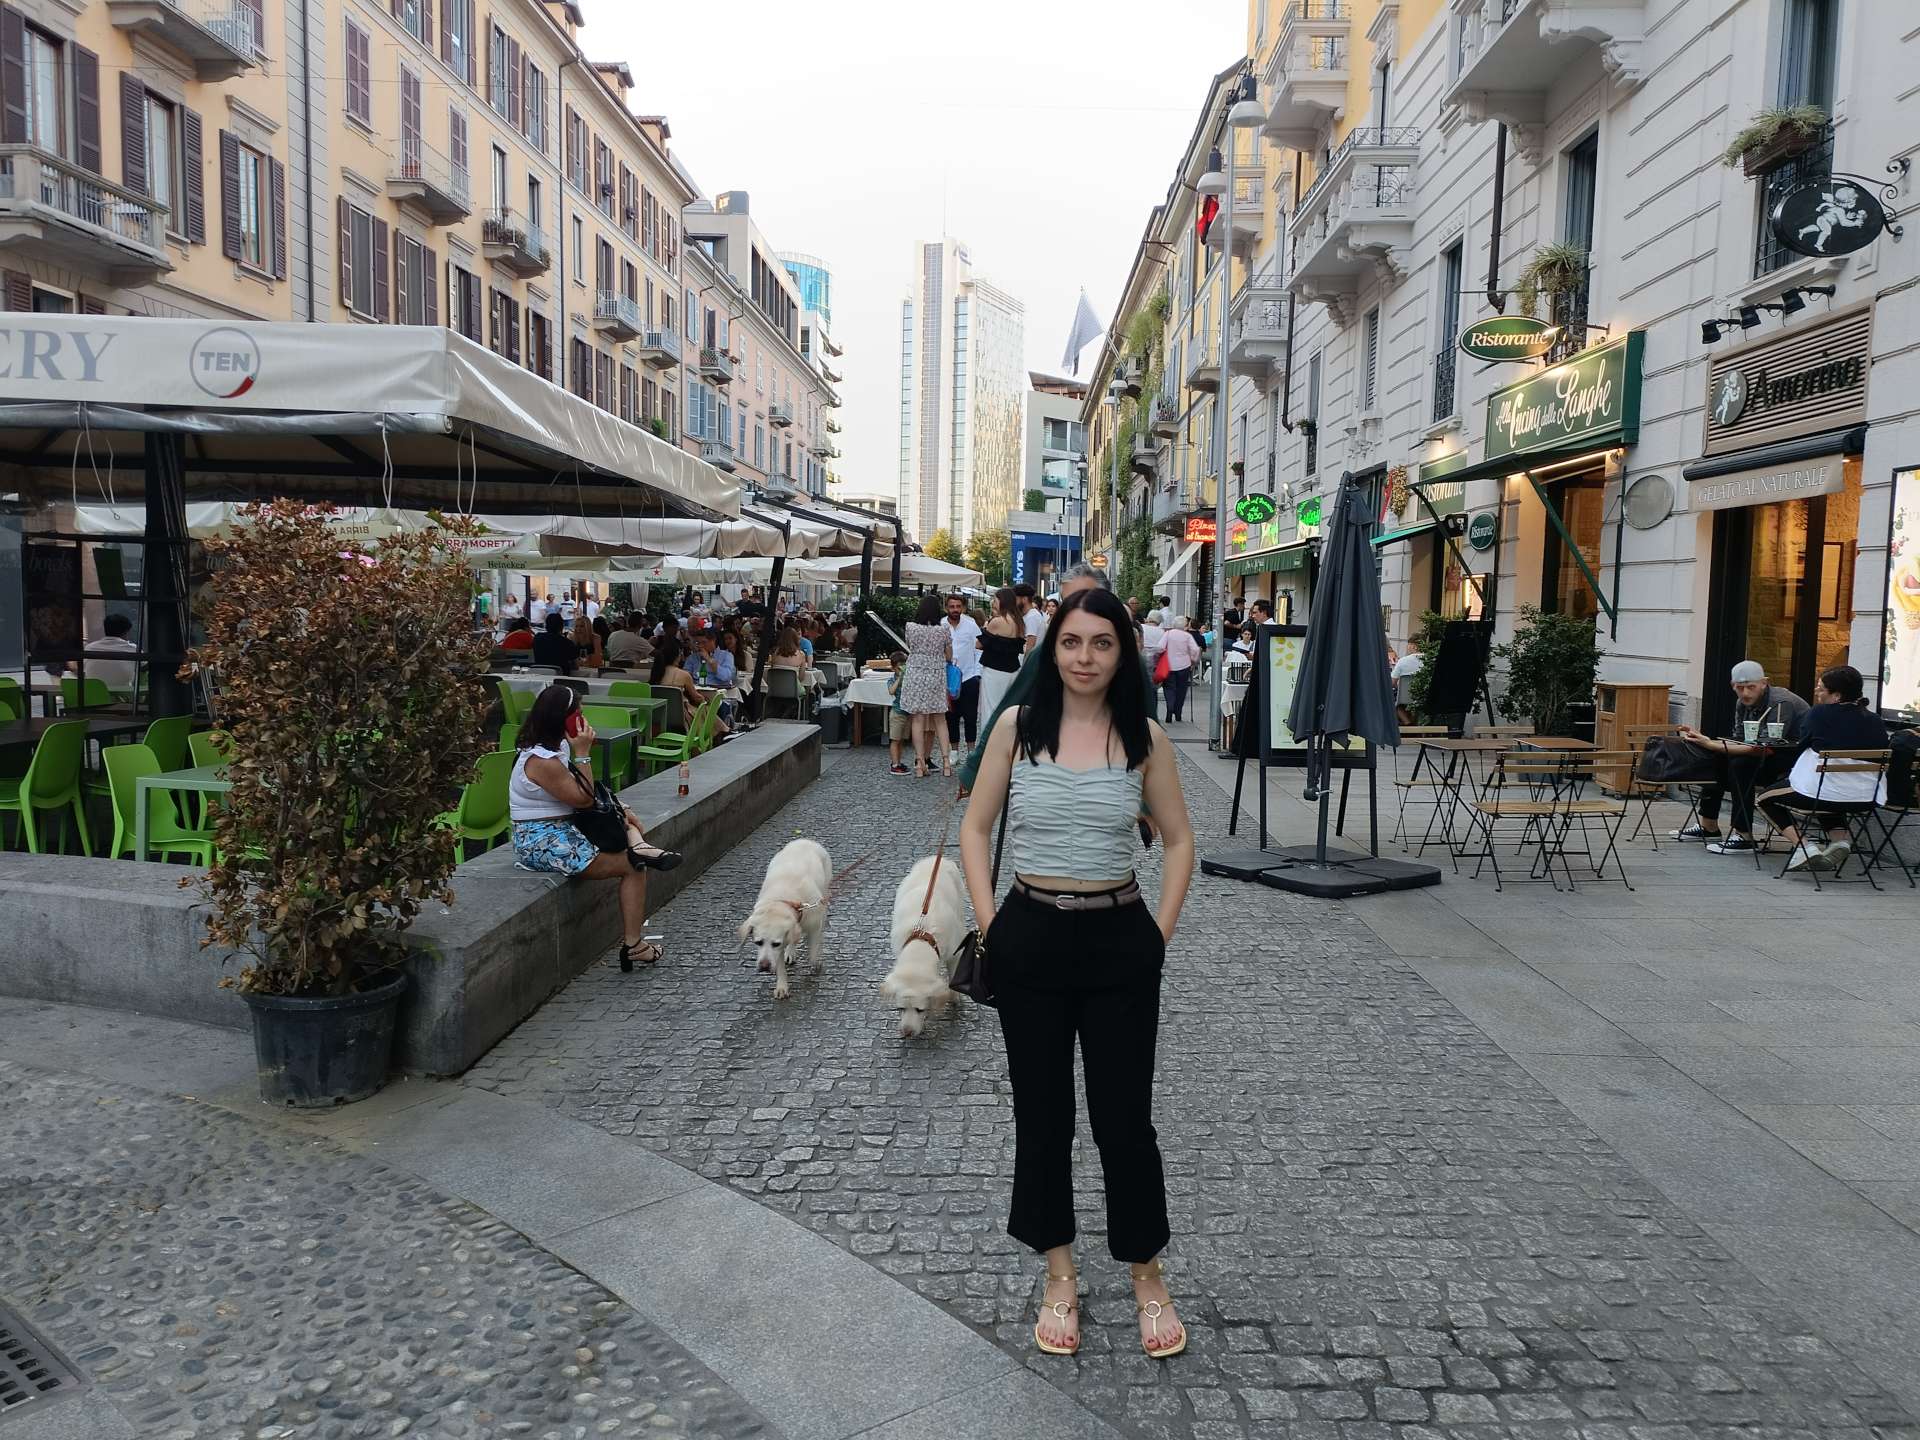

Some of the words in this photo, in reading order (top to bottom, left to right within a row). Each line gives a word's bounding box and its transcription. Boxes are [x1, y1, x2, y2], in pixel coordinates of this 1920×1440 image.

[1469, 331, 1550, 347] Ristorante
[200, 351, 250, 372] TEN
[1495, 400, 1511, 433] Alla
[1510, 392, 1541, 448] Cucina
[1541, 402, 1556, 427] delle
[1555, 358, 1612, 432] Langhe
[1760, 466, 1828, 492] NATURALE
[469, 540, 516, 548] MORETTI
[487, 561, 523, 570] Heineken
